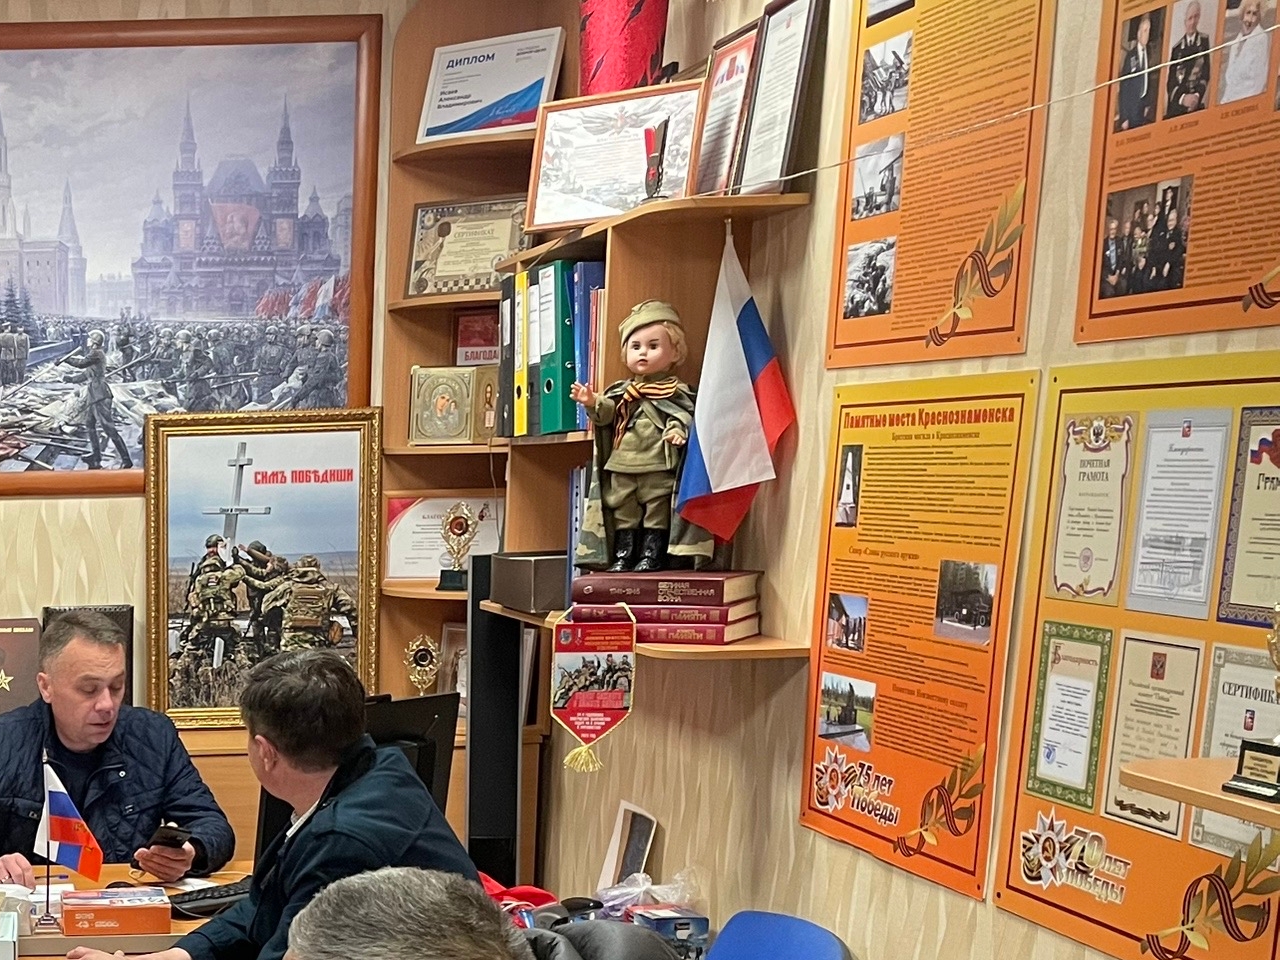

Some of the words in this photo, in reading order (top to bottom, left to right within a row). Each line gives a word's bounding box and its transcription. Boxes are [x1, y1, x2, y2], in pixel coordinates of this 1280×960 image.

[446, 53, 496, 69] ДИПЛОМ
[454, 228, 495, 239] СЕРТИФИКАТ
[464, 349, 499, 361] БЛАГОДА
[844, 412, 887, 429] Памятные
[888, 411, 917, 428] места
[918, 406, 1015, 429] Краснознаменска
[1079, 458, 1111, 469] ПОЧЕТНАЯ
[254, 470, 287, 485] СИМЪ
[1078, 471, 1110, 482] ГРАМОТА
[658, 588, 715, 596] ОТЕЧЕСТВЕННАЯ
[857, 762, 873, 781] 75
[872, 774, 895, 795] лет
[850, 794, 900, 826] Победы
[1066, 827, 1106, 869] 70
